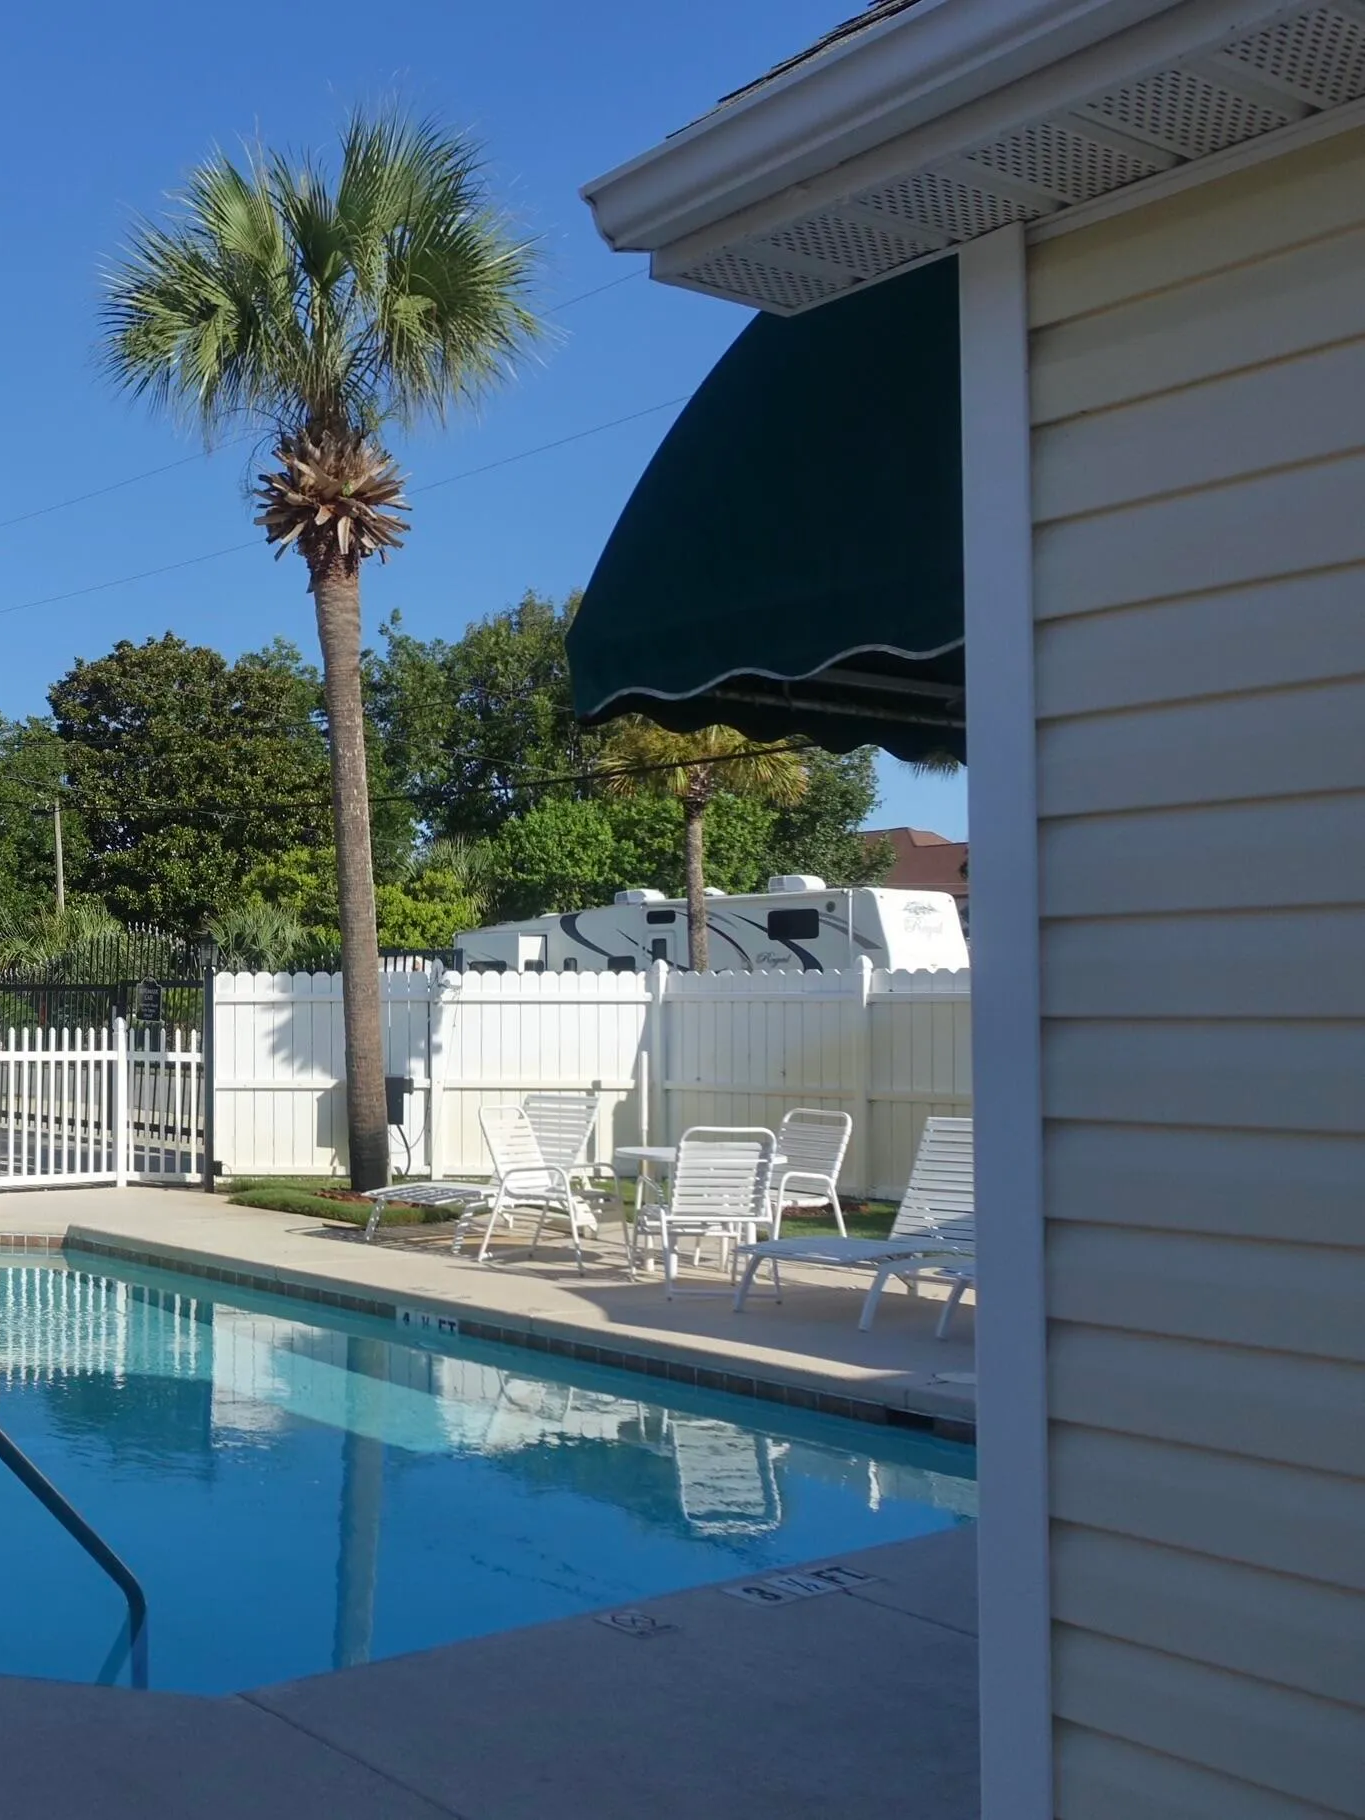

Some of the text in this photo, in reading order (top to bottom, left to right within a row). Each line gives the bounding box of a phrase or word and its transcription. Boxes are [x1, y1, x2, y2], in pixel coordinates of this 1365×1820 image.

[755, 951, 792, 968] Royal
[438, 1318, 457, 1332] FT
[742, 1586, 783, 1601] 3
[810, 1566, 870, 1585] FT
